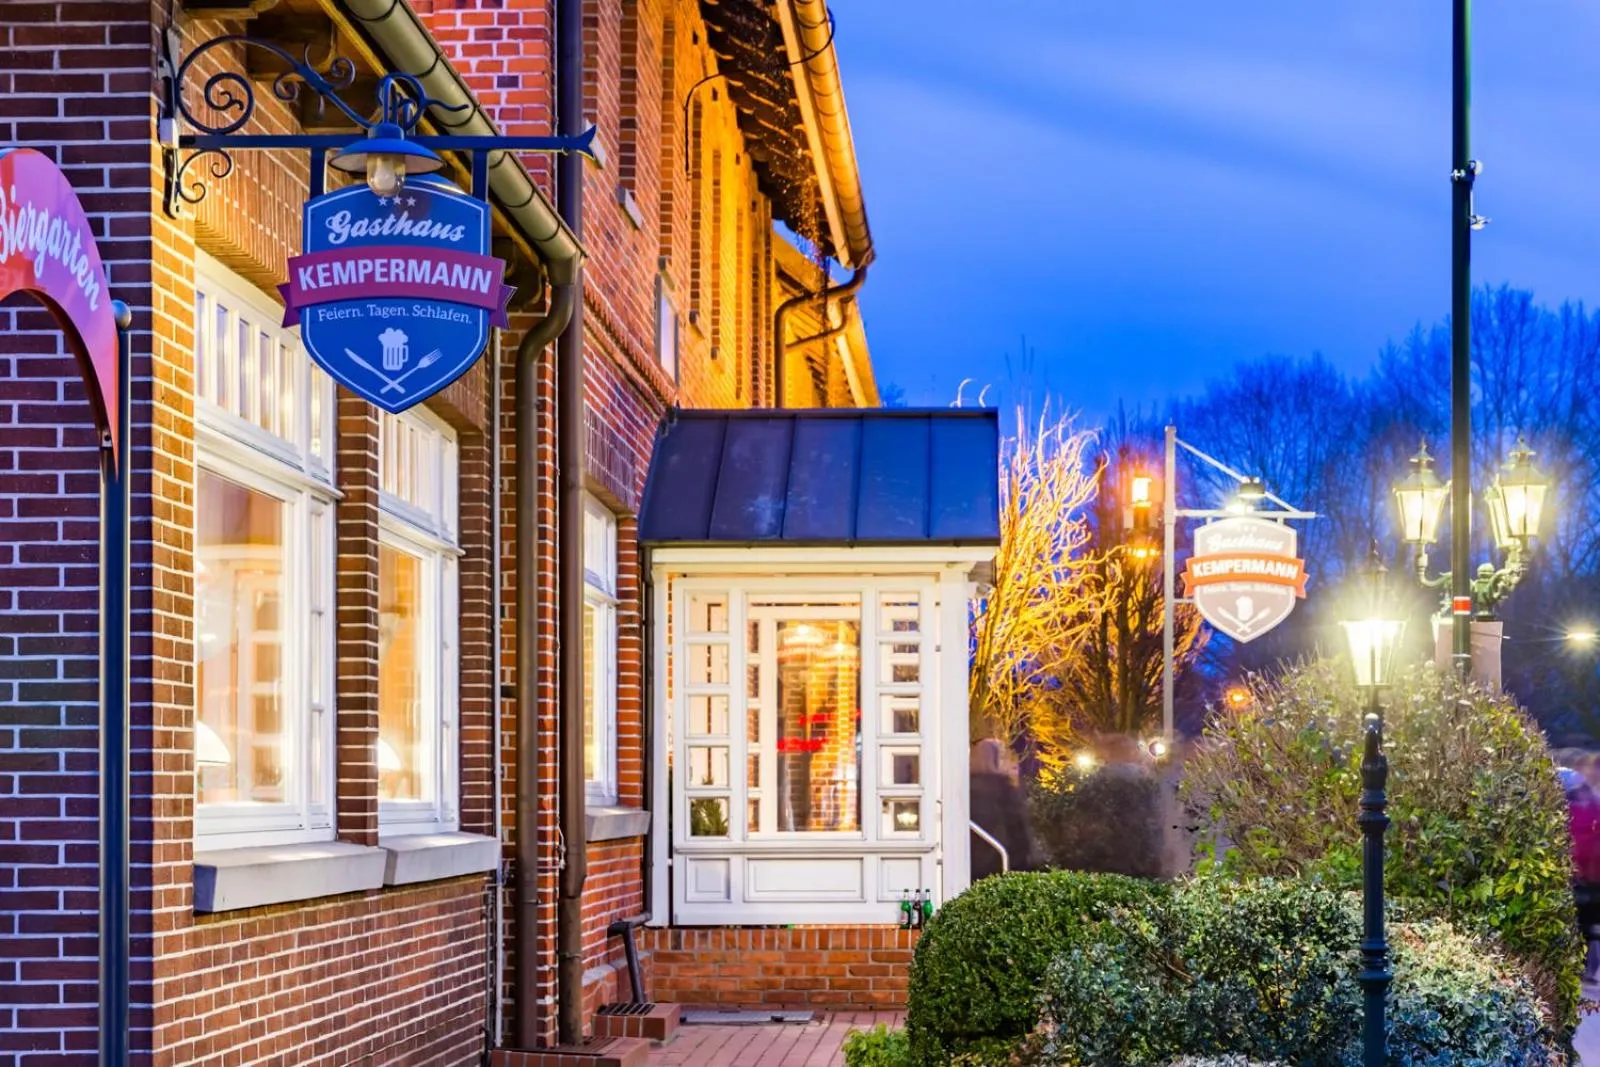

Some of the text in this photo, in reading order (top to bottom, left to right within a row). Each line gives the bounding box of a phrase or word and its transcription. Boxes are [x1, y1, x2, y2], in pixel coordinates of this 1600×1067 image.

[325, 210, 466, 244] Gasthaus
[298, 258, 492, 294] KEMPERMANN
[318, 304, 472, 324] Feiern. Tagen. Schlafen.
[1192, 558, 1299, 580] KEMPERMANN
